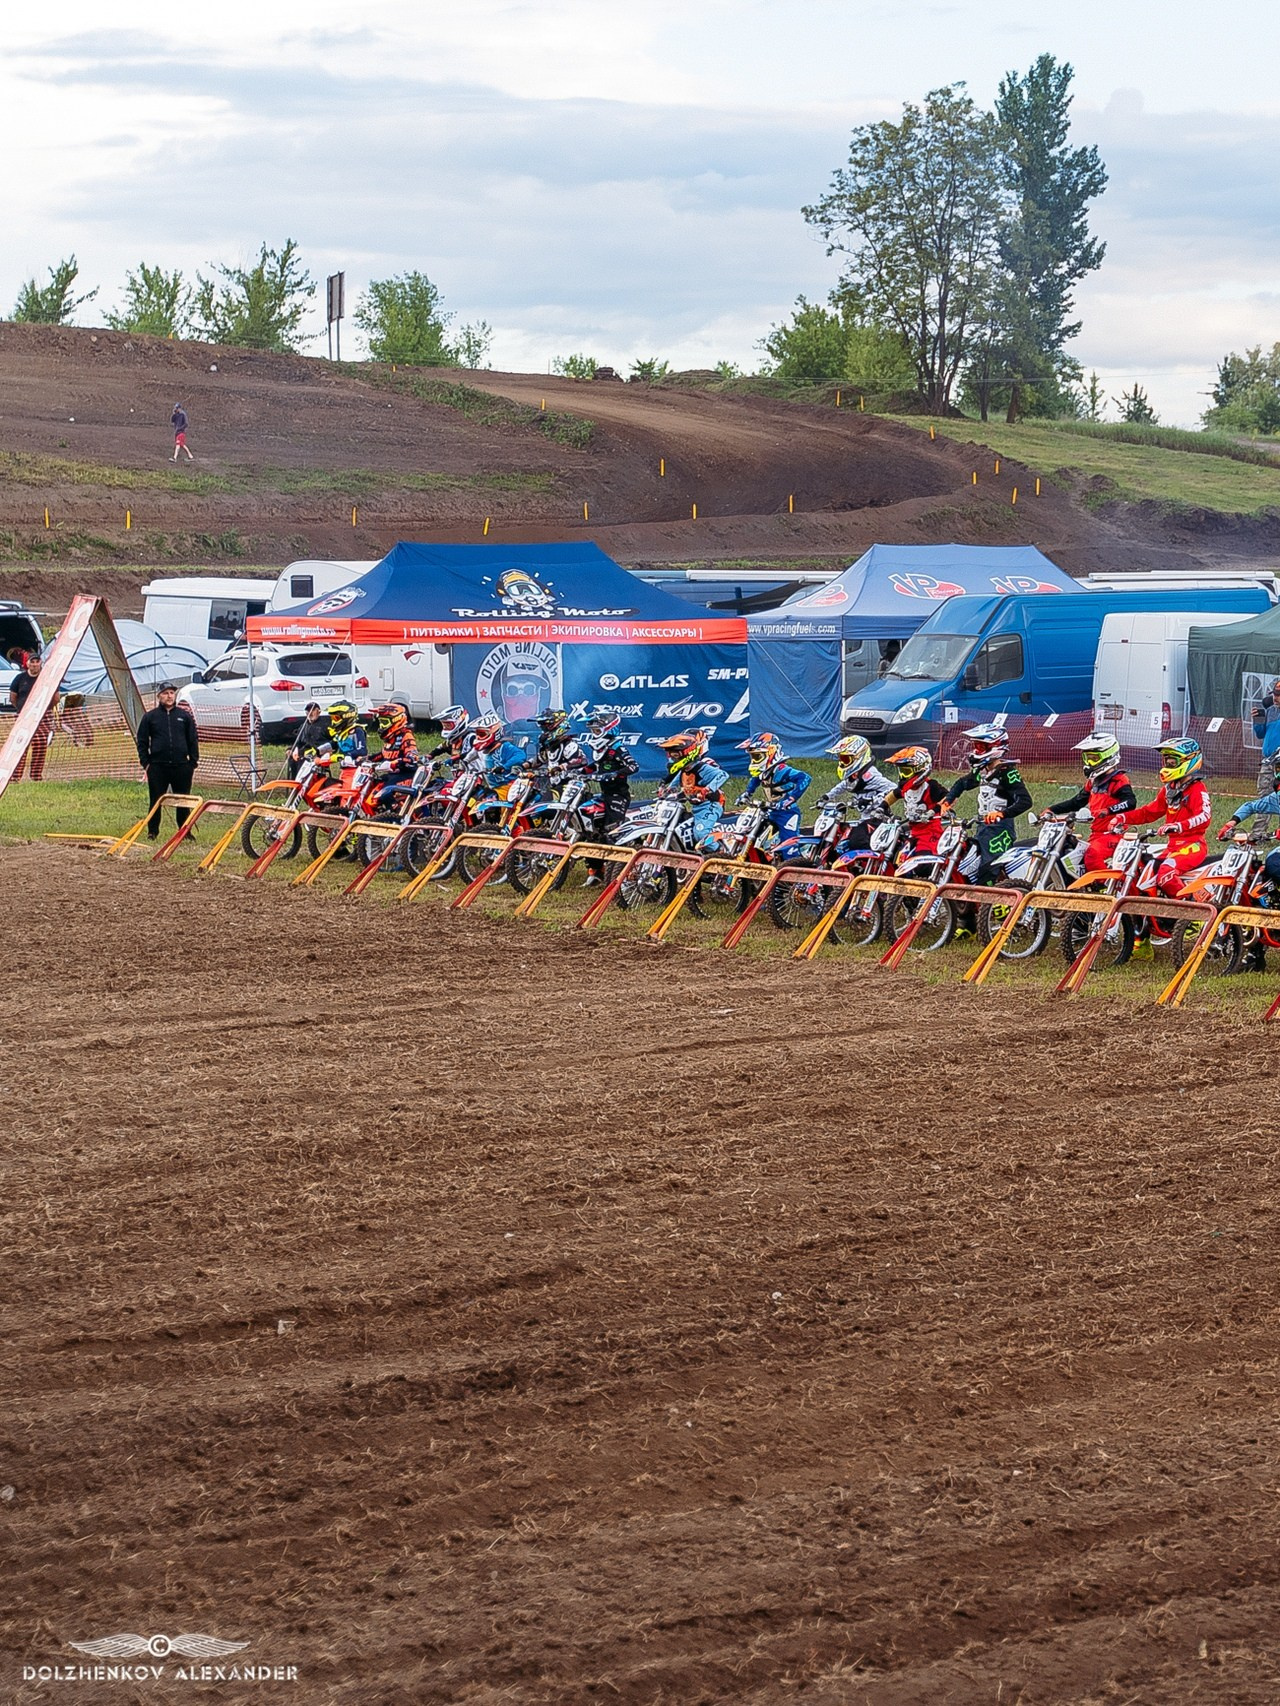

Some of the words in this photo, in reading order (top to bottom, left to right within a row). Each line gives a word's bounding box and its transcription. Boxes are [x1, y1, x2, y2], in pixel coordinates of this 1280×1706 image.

[452, 608, 554, 619] Rolling
[557, 607, 631, 616] Moto
[482, 625, 542, 636] ЗАПЧАСТИ
[551, 625, 623, 637] ЭКИПИРОВКА
[632, 627, 697, 637] АКСЕССУАРЫ
[620, 674, 689, 689] ATLAS
[654, 695, 724, 721] KAYO
[1153, 716, 1159, 725] 5
